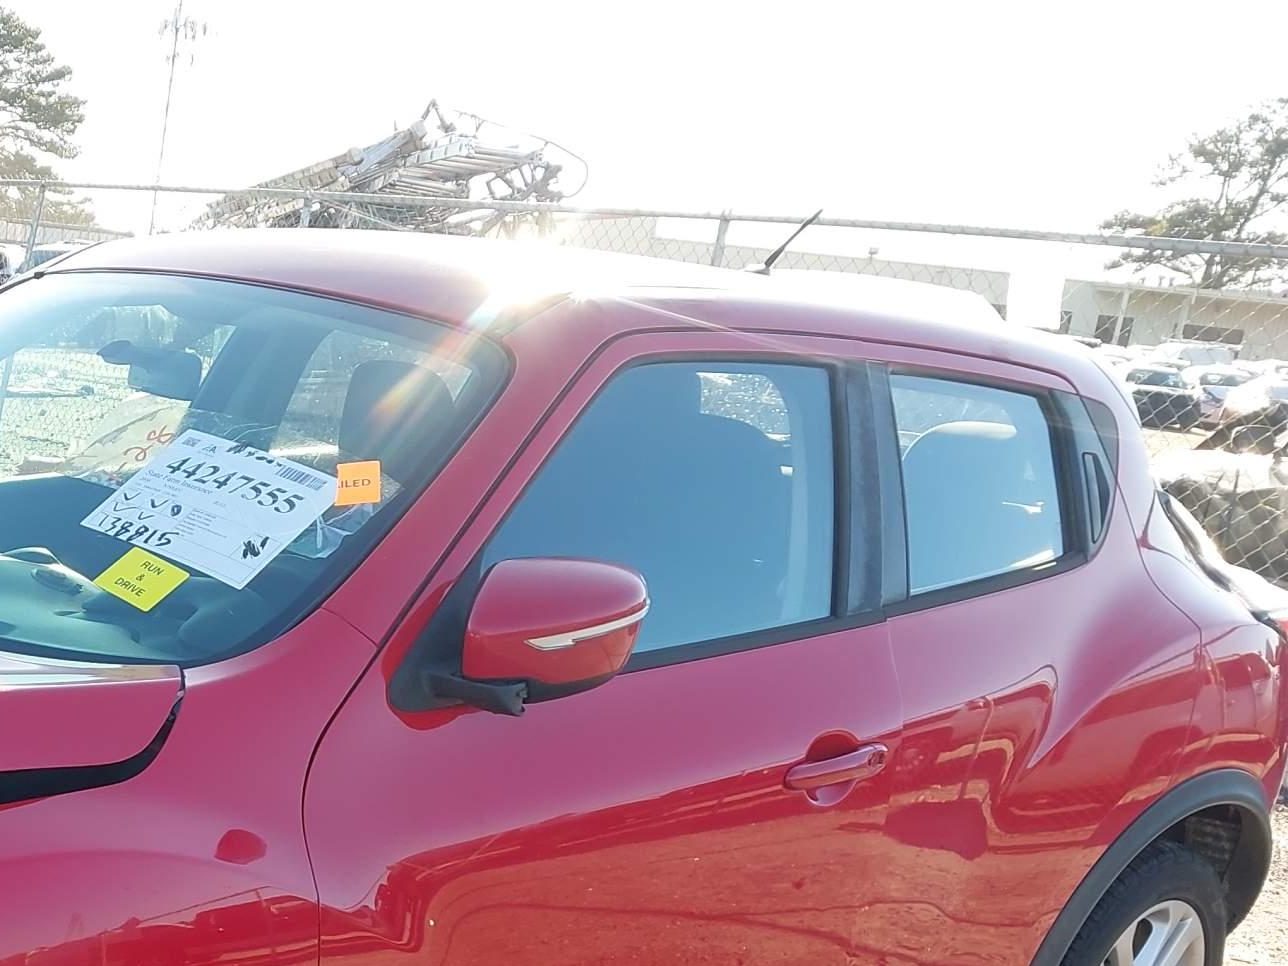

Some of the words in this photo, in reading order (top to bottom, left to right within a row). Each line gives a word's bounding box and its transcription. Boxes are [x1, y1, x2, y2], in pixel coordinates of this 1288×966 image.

[166, 456, 305, 514] 44247555
[338, 478, 371, 489] ILED
[140, 560, 164, 576] RUN
[135, 573, 145, 582] &
[114, 577, 146, 597] DRIVE
